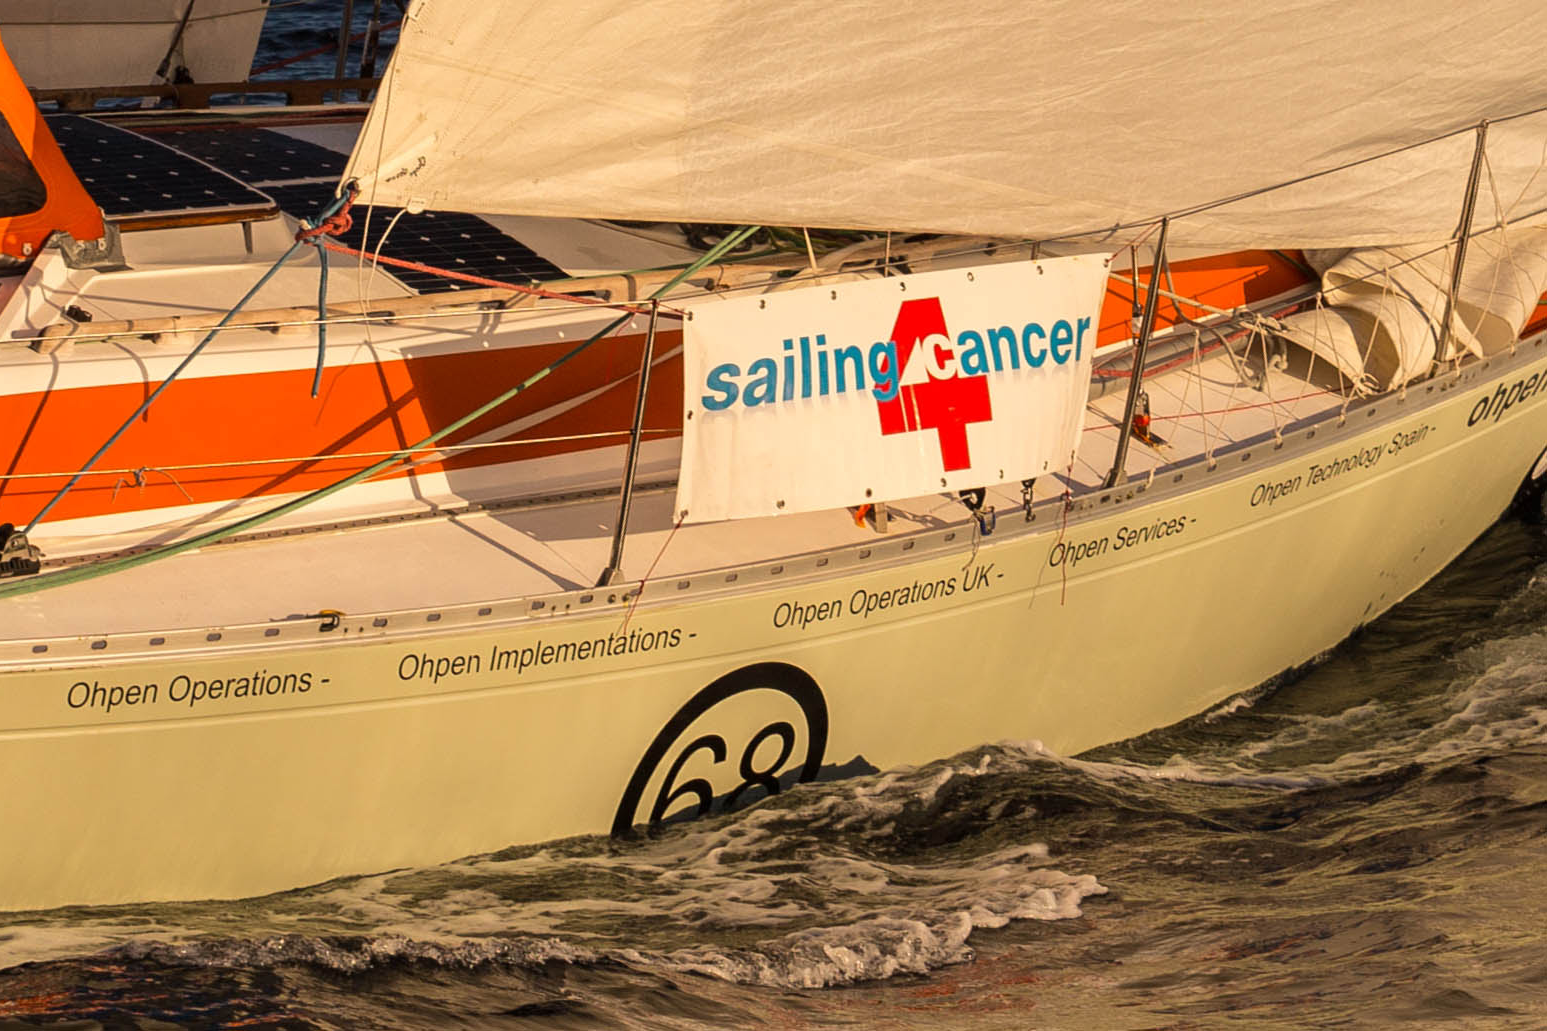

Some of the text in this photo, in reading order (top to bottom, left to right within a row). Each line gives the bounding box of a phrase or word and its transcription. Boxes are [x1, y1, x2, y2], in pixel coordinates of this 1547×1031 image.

[701, 334, 900, 412] sailing
[920, 316, 1091, 380] cancer
[1250, 475, 1302, 508] Ohpen
[1306, 442, 1386, 487] Technology
[1049, 536, 1109, 568] Ohpen
[1113, 515, 1187, 551] Services
[772, 599, 843, 630] Ohpen
[849, 576, 956, 619] Operations
[963, 563, 995, 593] UK
[398, 653, 480, 684] Ohpen
[489, 626, 682, 674] Implementations
[67, 681, 158, 713] Ohpen
[168, 669, 312, 708] Operations
[647, 721, 796, 834] 68
